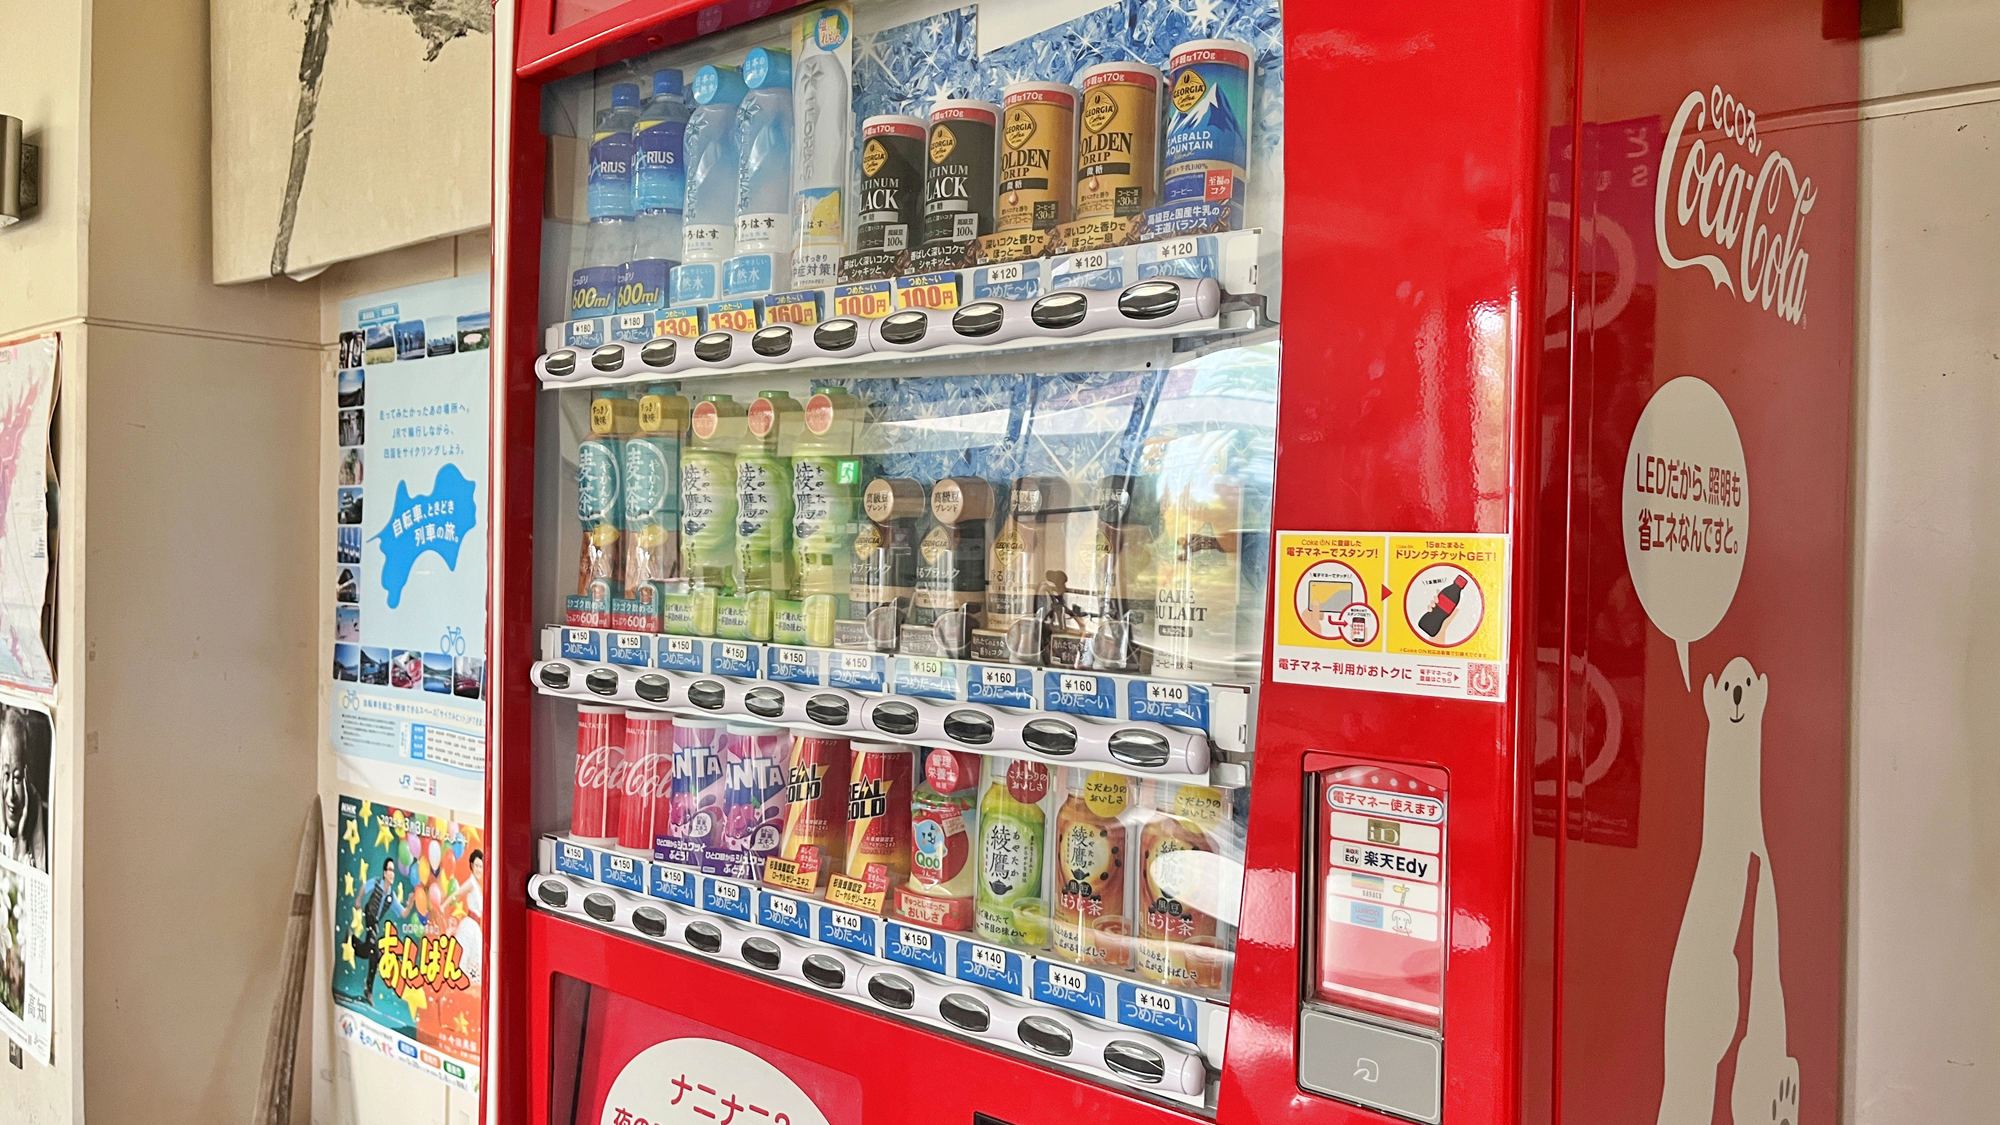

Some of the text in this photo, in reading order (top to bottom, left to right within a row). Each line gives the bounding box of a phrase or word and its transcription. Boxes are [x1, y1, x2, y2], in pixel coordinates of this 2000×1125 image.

[745, 57, 765, 71] 日本の
[1173, 84, 1204, 99] GEORGIA
[1085, 104, 1114, 118] GEORGIA
[1005, 122, 1033, 135] GEORGIA
[1167, 130, 1211, 147] EMERALD
[1165, 140, 1214, 158] MOUNTAIN
[1083, 151, 1110, 166] DRIP
[1003, 168, 1030, 179] DRIP
[1209, 176, 1230, 186] 至福の
[1171, 188, 1193, 198] コーヒー
[1211, 185, 1226, 195] コク
[1148, 204, 1220, 226] 高級豆と国産牛乳の
[1655, 90, 1818, 326] Coca-Cola
[956, 226, 973, 237] 100%
[1064, 221, 1126, 237] 深いコクと香りで
[1154, 217, 1208, 236] 王道バランス
[985, 234, 1044, 250] 深いコクと香りで
[1072, 232, 1114, 247] ほっと一息
[910, 244, 965, 262] 香ばしく深いコクで
[993, 245, 1032, 258] ほっと一息
[1162, 242, 1193, 258] ¥120
[843, 254, 896, 270] 香ばしく深いコクで
[918, 256, 956, 269] シャキッと、
[1075, 255, 1103, 269] ¥120
[992, 267, 1017, 281] ¥120
[572, 286, 611, 311] 600ml
[617, 282, 659, 310] 600ml
[901, 285, 954, 308] 100円
[836, 294, 886, 316] 100円
[711, 310, 754, 331] 130円
[769, 303, 814, 325] 160円
[576, 323, 591, 334] ¥180
[623, 317, 641, 327] ¥180
[658, 317, 697, 337] 130円
[577, 448, 598, 514] 麦茶
[599, 460, 611, 506] やかんの
[626, 447, 646, 514] 麦茶
[648, 459, 660, 504] やかんの
[1636, 452, 1742, 508] LEDだから、照明も
[684, 463, 702, 518] 綾鷹
[702, 467, 713, 516] あやたか
[738, 462, 757, 519] 綾鷹
[757, 466, 769, 516] あやたか
[796, 461, 815, 520] 綾鷹
[815, 465, 827, 517] あやたか
[866, 491, 890, 504] 高級豆
[934, 491, 959, 504] 高級豆
[867, 503, 888, 512] ブレンド
[935, 503, 959, 513] ブレンド
[1011, 502, 1037, 512] ブレンド
[392, 500, 455, 538] 自転車、ときどき
[414, 521, 459, 547] 列車の旅。
[1638, 507, 1739, 555] 省エネなんですと。
[1301, 538, 1320, 546] Coke
[1425, 540, 1466, 549] 15個たまると
[1286, 546, 1379, 559] 電子マネーでスタンプ!
[1395, 549, 1498, 562] ドリンクチケットGET!
[1168, 606, 1208, 623] LAIT
[572, 632, 588, 641] ¥150
[621, 636, 639, 647] ¥150
[671, 640, 690, 651] ¥150
[725, 647, 745, 660] ¥150
[782, 652, 804, 664] ¥150
[845, 656, 868, 669] ¥150
[913, 660, 937, 674] ¥150
[1278, 657, 1413, 681] 電子マネー利用がおトクに
[986, 671, 1012, 685] ¥160
[1419, 668, 1453, 677] 電子マネーの
[1419, 674, 1453, 684] 登録はこちら
[1064, 679, 1093, 693] ¥160
[1152, 686, 1183, 701] ¥140
[932, 754, 952, 768] 管理
[399, 774, 411, 786] JR
[928, 766, 957, 783] 栄養士
[1011, 781, 1044, 792] おいしさ
[1086, 782, 1128, 794] こだわりの
[1089, 794, 1124, 805] おいしさ
[1177, 796, 1222, 809] こだわりの
[1332, 790, 1439, 817] 電子マネー使えます
[341, 802, 357, 815] NHK
[1180, 808, 1217, 820] おいしさ
[1368, 825, 1400, 845] iD
[566, 847, 582, 859] ¥150
[989, 824, 1011, 880] 綾鷹
[1070, 825, 1088, 868] 綾鷹
[1087, 830, 1095, 867] あやたか
[669, 850, 689, 862] ぶどう!
[916, 852, 941, 870] Qoo
[1011, 831, 1020, 878] あやたか
[1345, 854, 1360, 864] Edy
[613, 858, 631, 871] ¥150
[1364, 849, 1428, 878] 楽天Edy
[663, 870, 682, 883] ¥150
[771, 871, 810, 887] ローヤルゼリーエキス
[717, 885, 736, 899] ¥150
[835, 891, 877, 908] ローヤルゼリーエキス
[773, 900, 794, 915] ¥140
[1060, 895, 1104, 917] ほうじ茶
[836, 915, 858, 930] ¥140
[907, 907, 940, 923] おいしさ
[1147, 912, 1196, 937] ほうじ茶
[904, 931, 928, 947] ¥150
[378, 921, 468, 994] あんぱん
[976, 949, 1002, 965] ¥140
[1053, 972, 1081, 990] ¥140
[27, 991, 47, 1022] 高知
[1140, 994, 1171, 1011] ¥140
